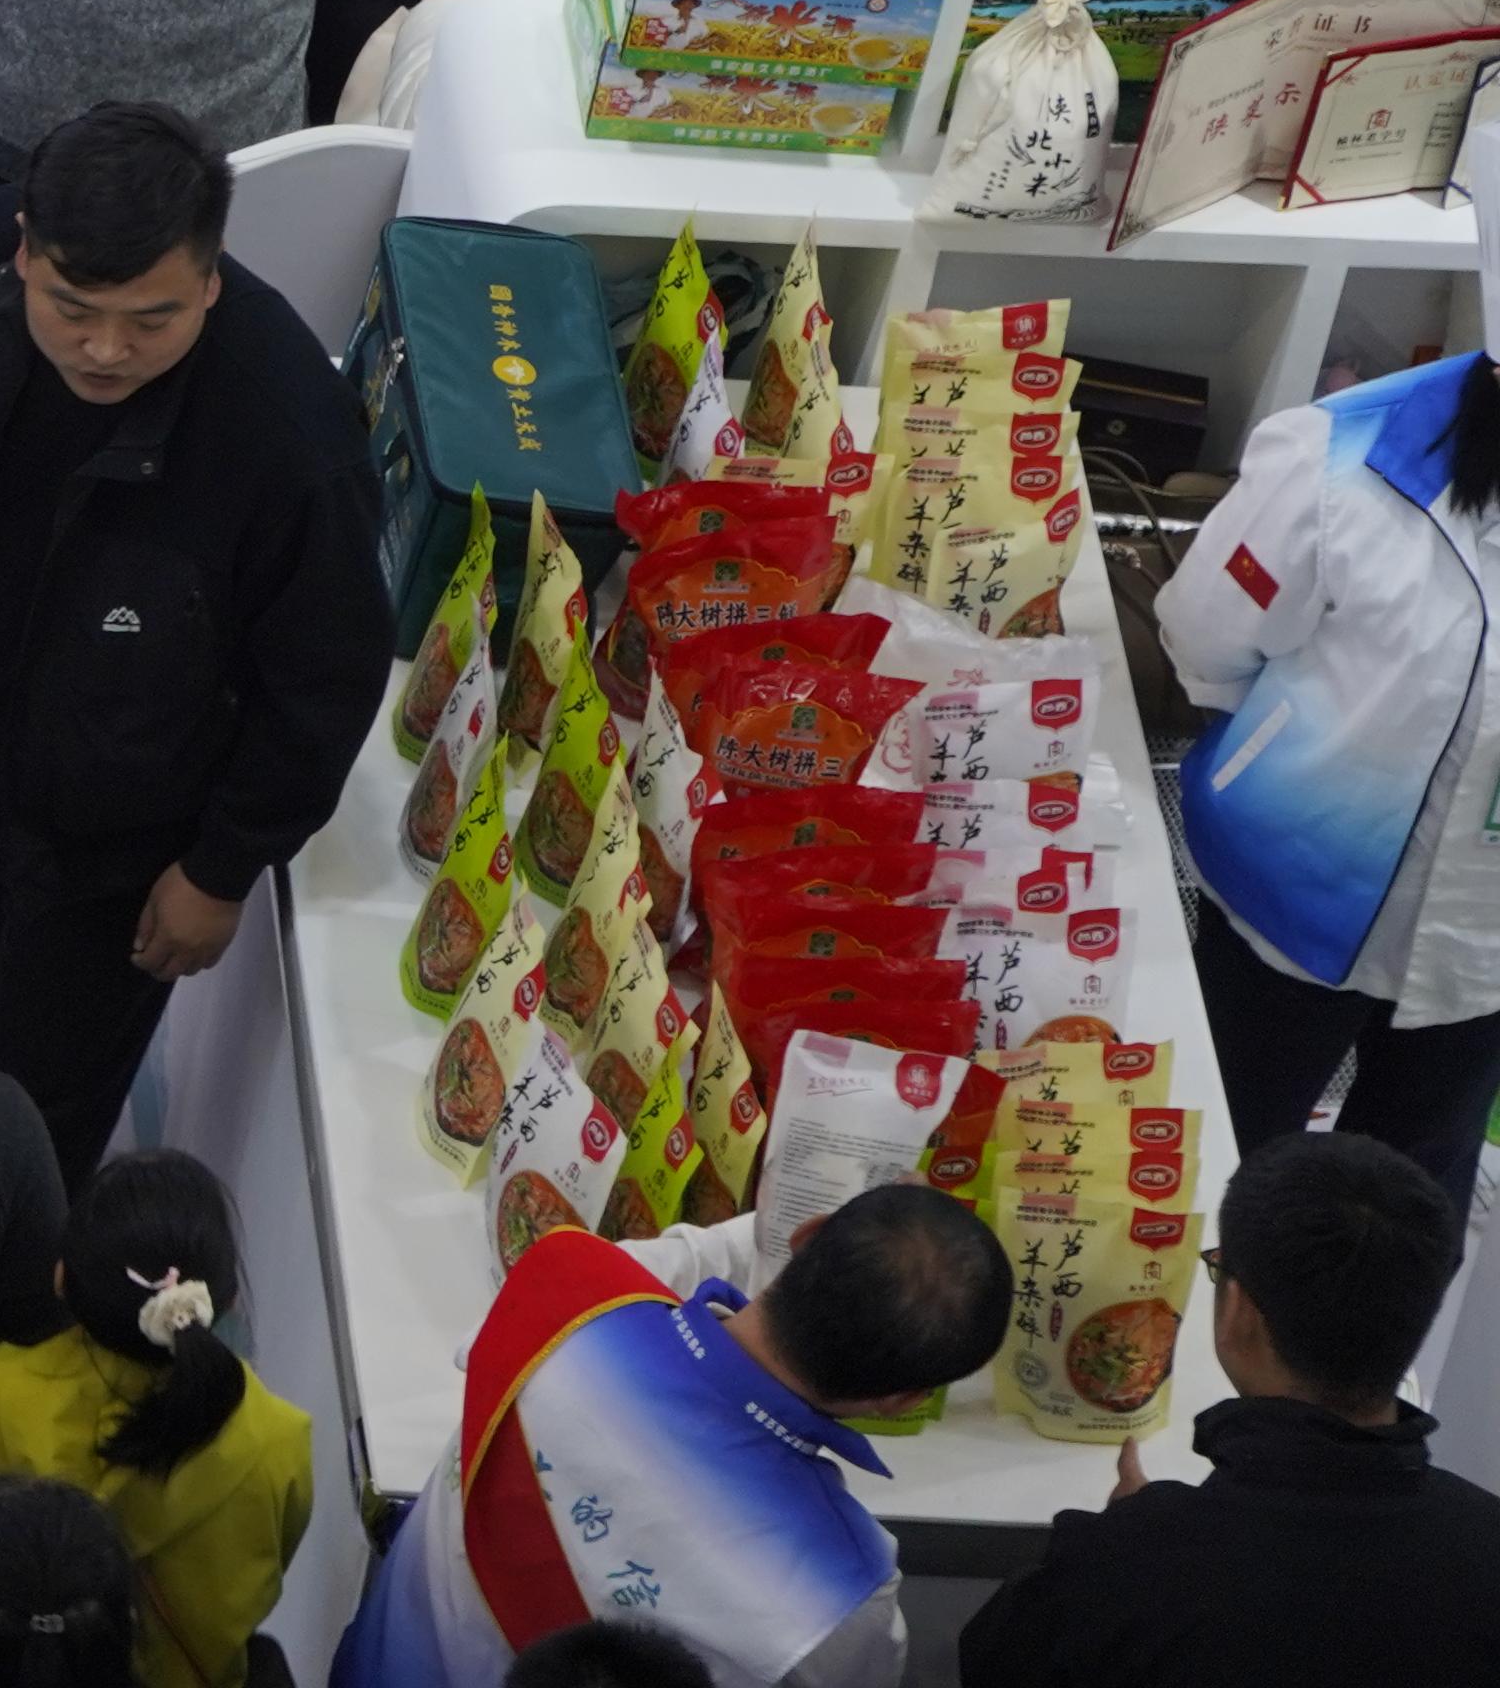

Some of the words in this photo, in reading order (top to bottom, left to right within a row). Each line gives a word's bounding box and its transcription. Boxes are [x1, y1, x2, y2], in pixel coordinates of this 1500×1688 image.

[1025, 93, 1072, 197] 陕北小米
[980, 542, 1009, 605] 芦西
[715, 735, 845, 780] 陈大树拼三
[962, 721, 990, 782] 芦西
[994, 940, 1024, 1014] 芦西
[518, 1084, 563, 1145] 芦西
[1012, 1238, 1048, 1350] 羊杂碎
[1051, 1229, 1084, 1298] 芦西
